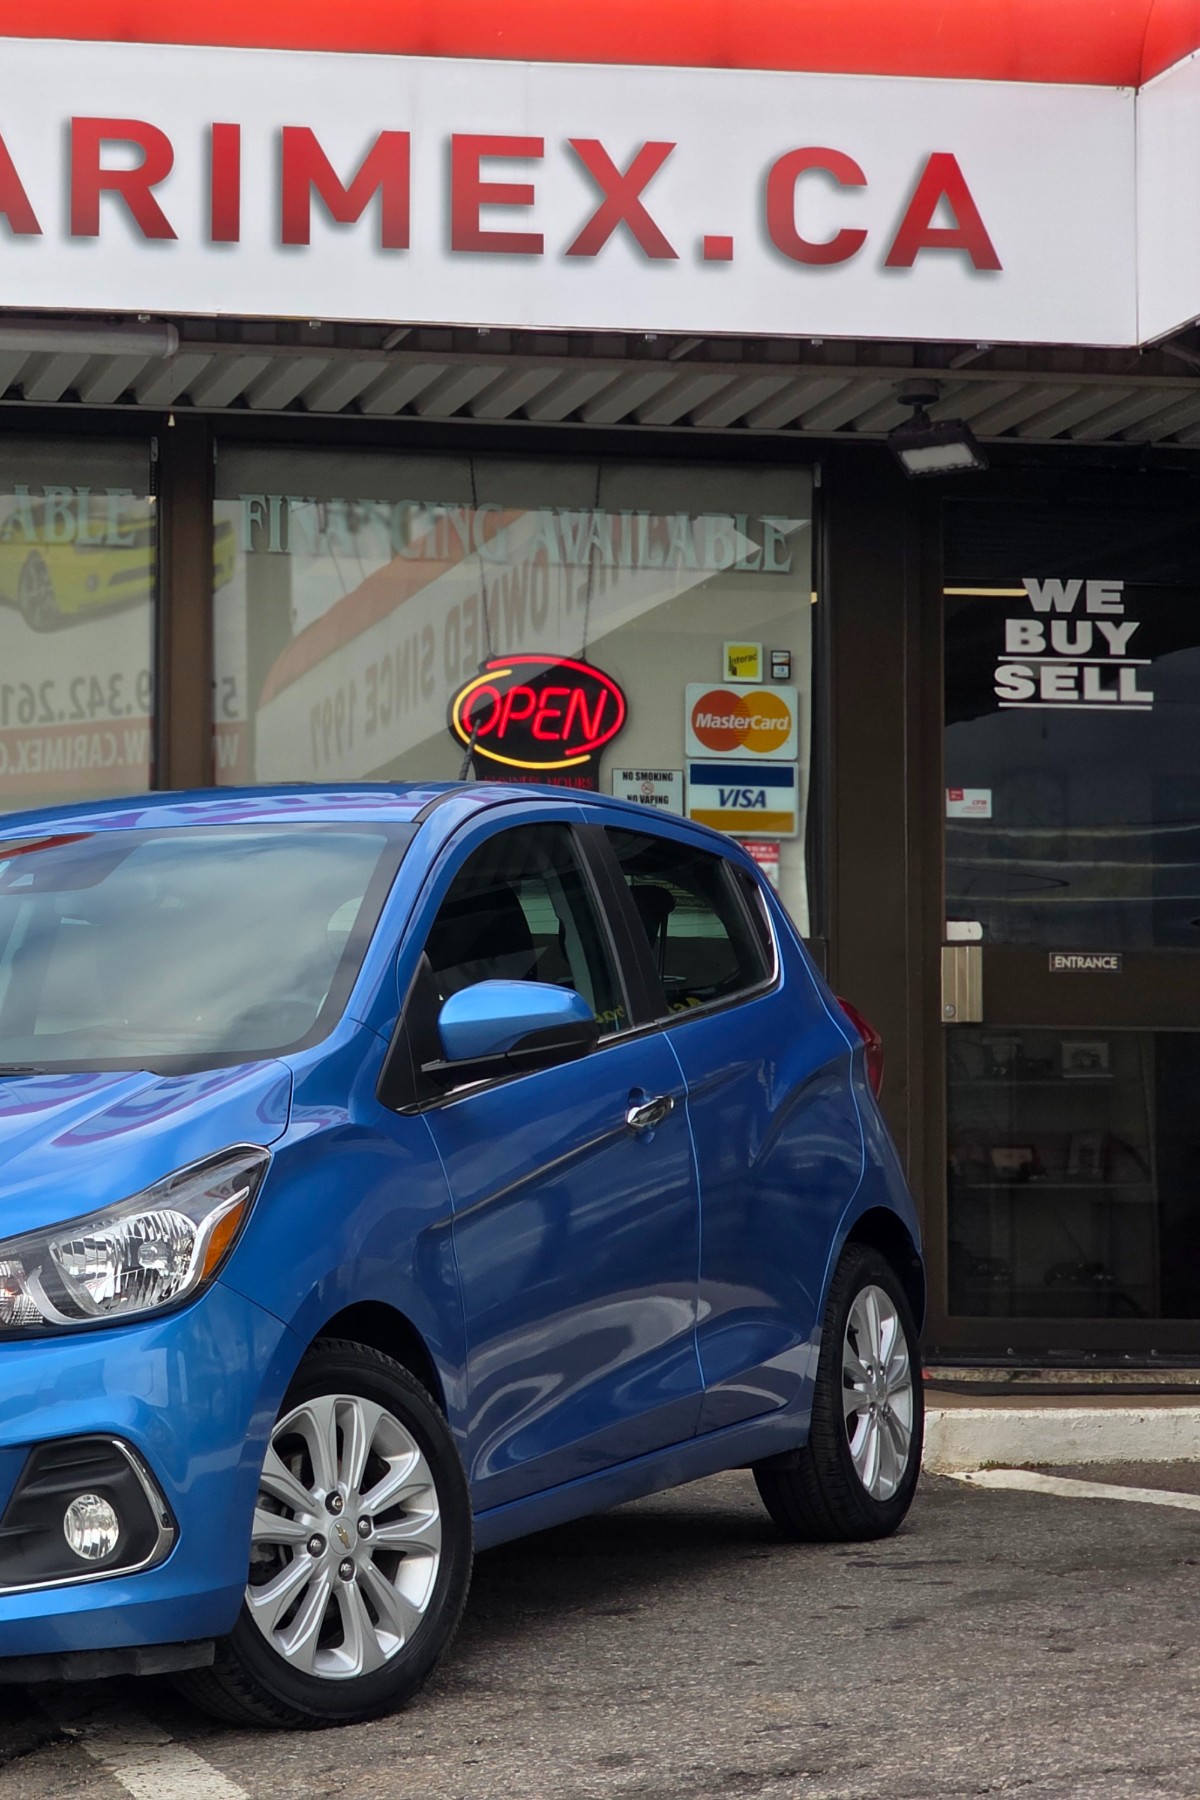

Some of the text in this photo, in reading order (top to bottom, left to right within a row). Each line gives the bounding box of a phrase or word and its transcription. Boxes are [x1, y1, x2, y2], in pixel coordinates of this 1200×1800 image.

[529, 507, 792, 573] AVAILABLE
[1022, 577, 1125, 615] WE
[1005, 618, 1140, 656] BUY
[993, 664, 1154, 702] SELL
[461, 685, 608, 741] OPEN
[695, 713, 790, 731] MasterCard
[622, 771, 674, 782] NO SMOKING
[627, 794, 669, 805] NO VAPING
[718, 788, 767, 809] VISA
[1053, 955, 1119, 970] ENTRANCE
